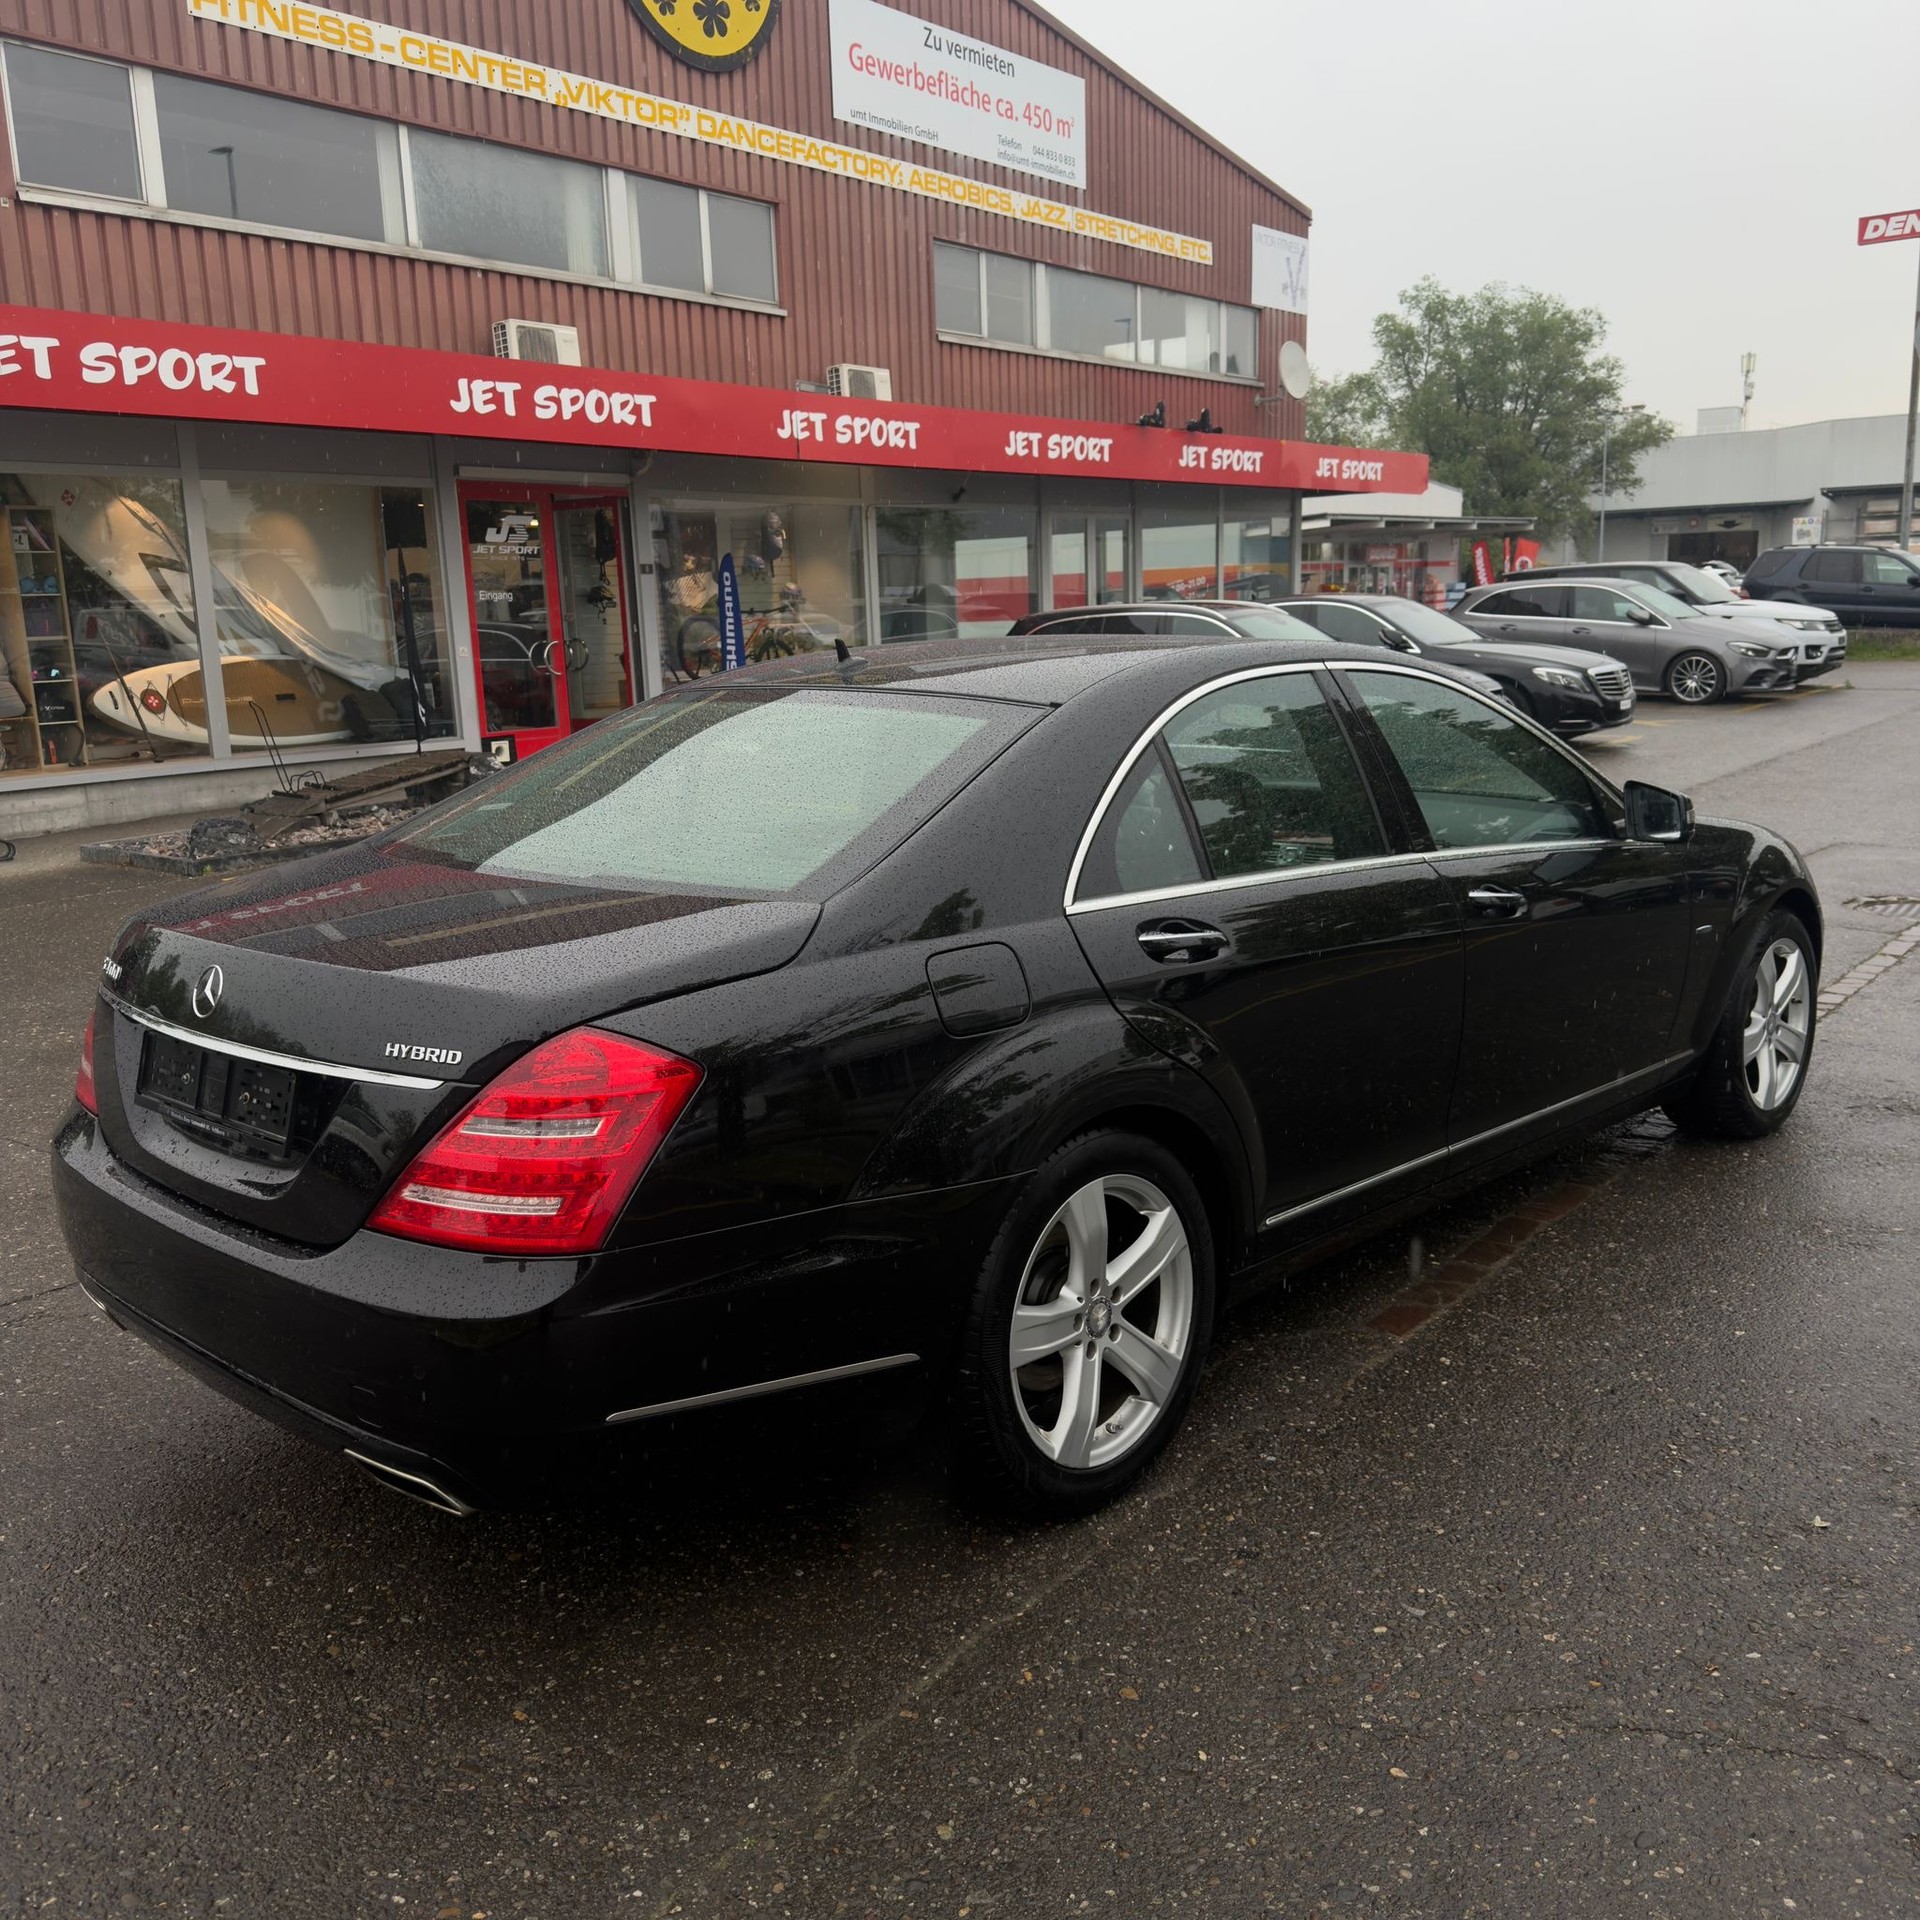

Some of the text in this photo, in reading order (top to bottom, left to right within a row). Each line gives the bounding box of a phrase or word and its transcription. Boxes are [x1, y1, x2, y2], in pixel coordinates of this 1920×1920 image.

[923, 26, 1016, 78] Zu vermieten
[848, 42, 991, 113] Gewerbefläche
[996, 97, 1020, 122] ca.
[1023, 102, 1053, 132] 450
[850, 109, 939, 142] umt Immobilien GmbH
[997, 134, 1023, 151] Telefon
[1032, 145, 1044, 156] 044
[1045, 149, 1057, 161] 833
[1063, 154, 1076, 167] 833
[0, 334, 266, 395] ET SPORT
[450, 378, 656, 427] JET SPORT
[777, 410, 920, 449] JET SPORT
[1005, 431, 1113, 463] JET SPORT
[1179, 445, 1263, 473] JET SPORT
[1316, 457, 1383, 481] JET SPORT
[472, 545, 540, 555] JET SPORT
[479, 591, 513, 602] Eingang
[385, 1042, 463, 1065] HYBRID
